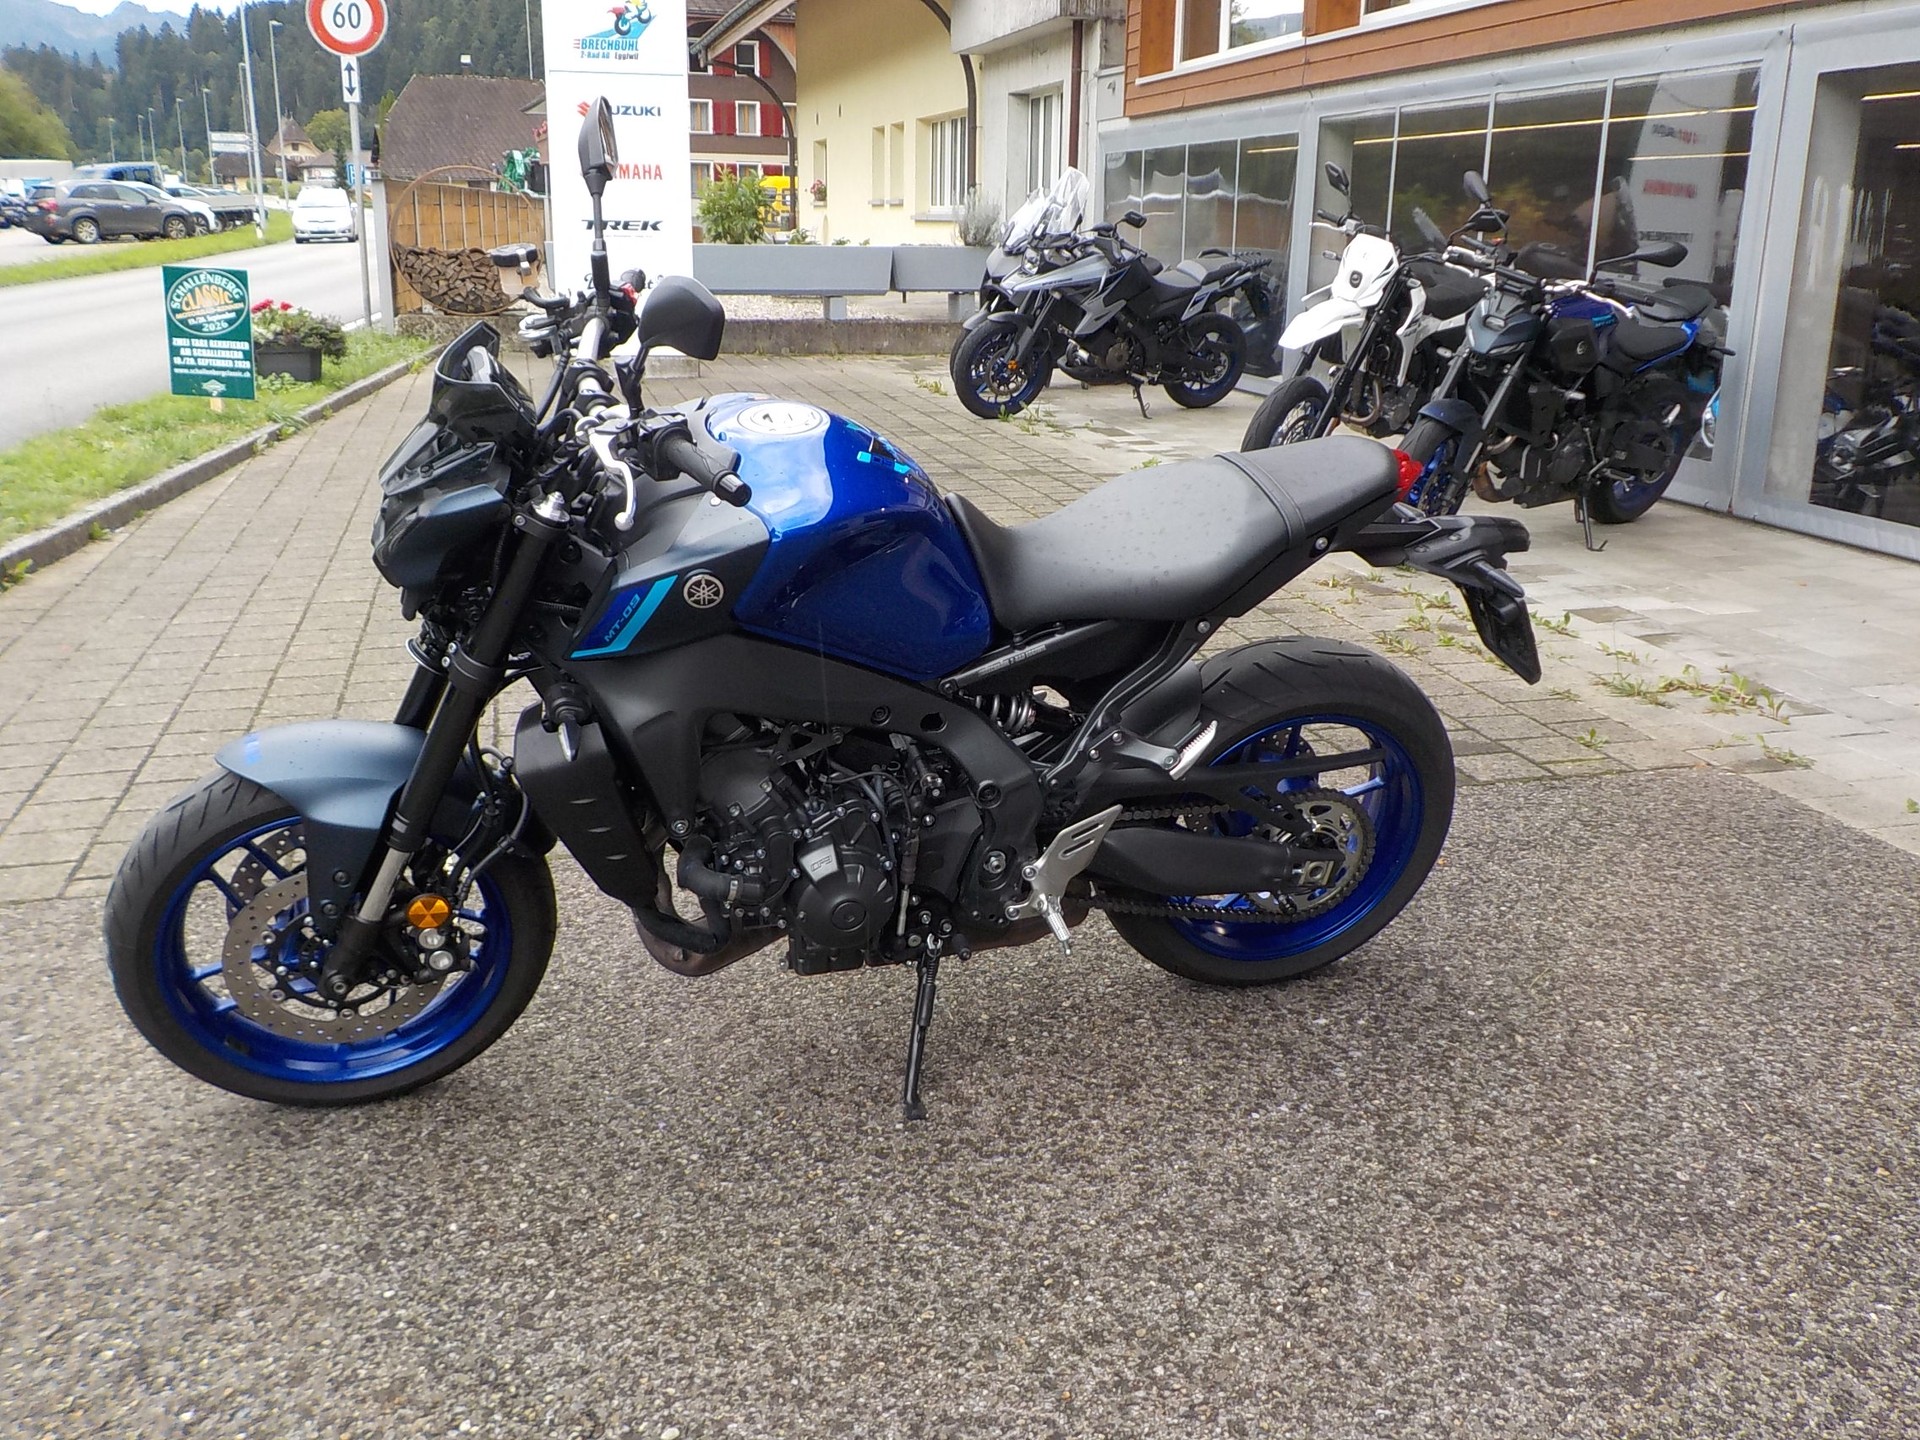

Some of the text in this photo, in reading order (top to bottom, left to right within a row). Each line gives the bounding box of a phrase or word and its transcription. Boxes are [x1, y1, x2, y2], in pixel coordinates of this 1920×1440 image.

[333, 2, 361, 29] 60
[611, 105, 661, 117] UZUKI
[614, 163, 663, 180] MAHA
[581, 219, 663, 231] TREK
[171, 272, 243, 310] SCHALLENBERG
[182, 284, 235, 311] CLASSIC
[202, 320, 229, 332] 2026
[604, 593, 641, 642] MT-09
